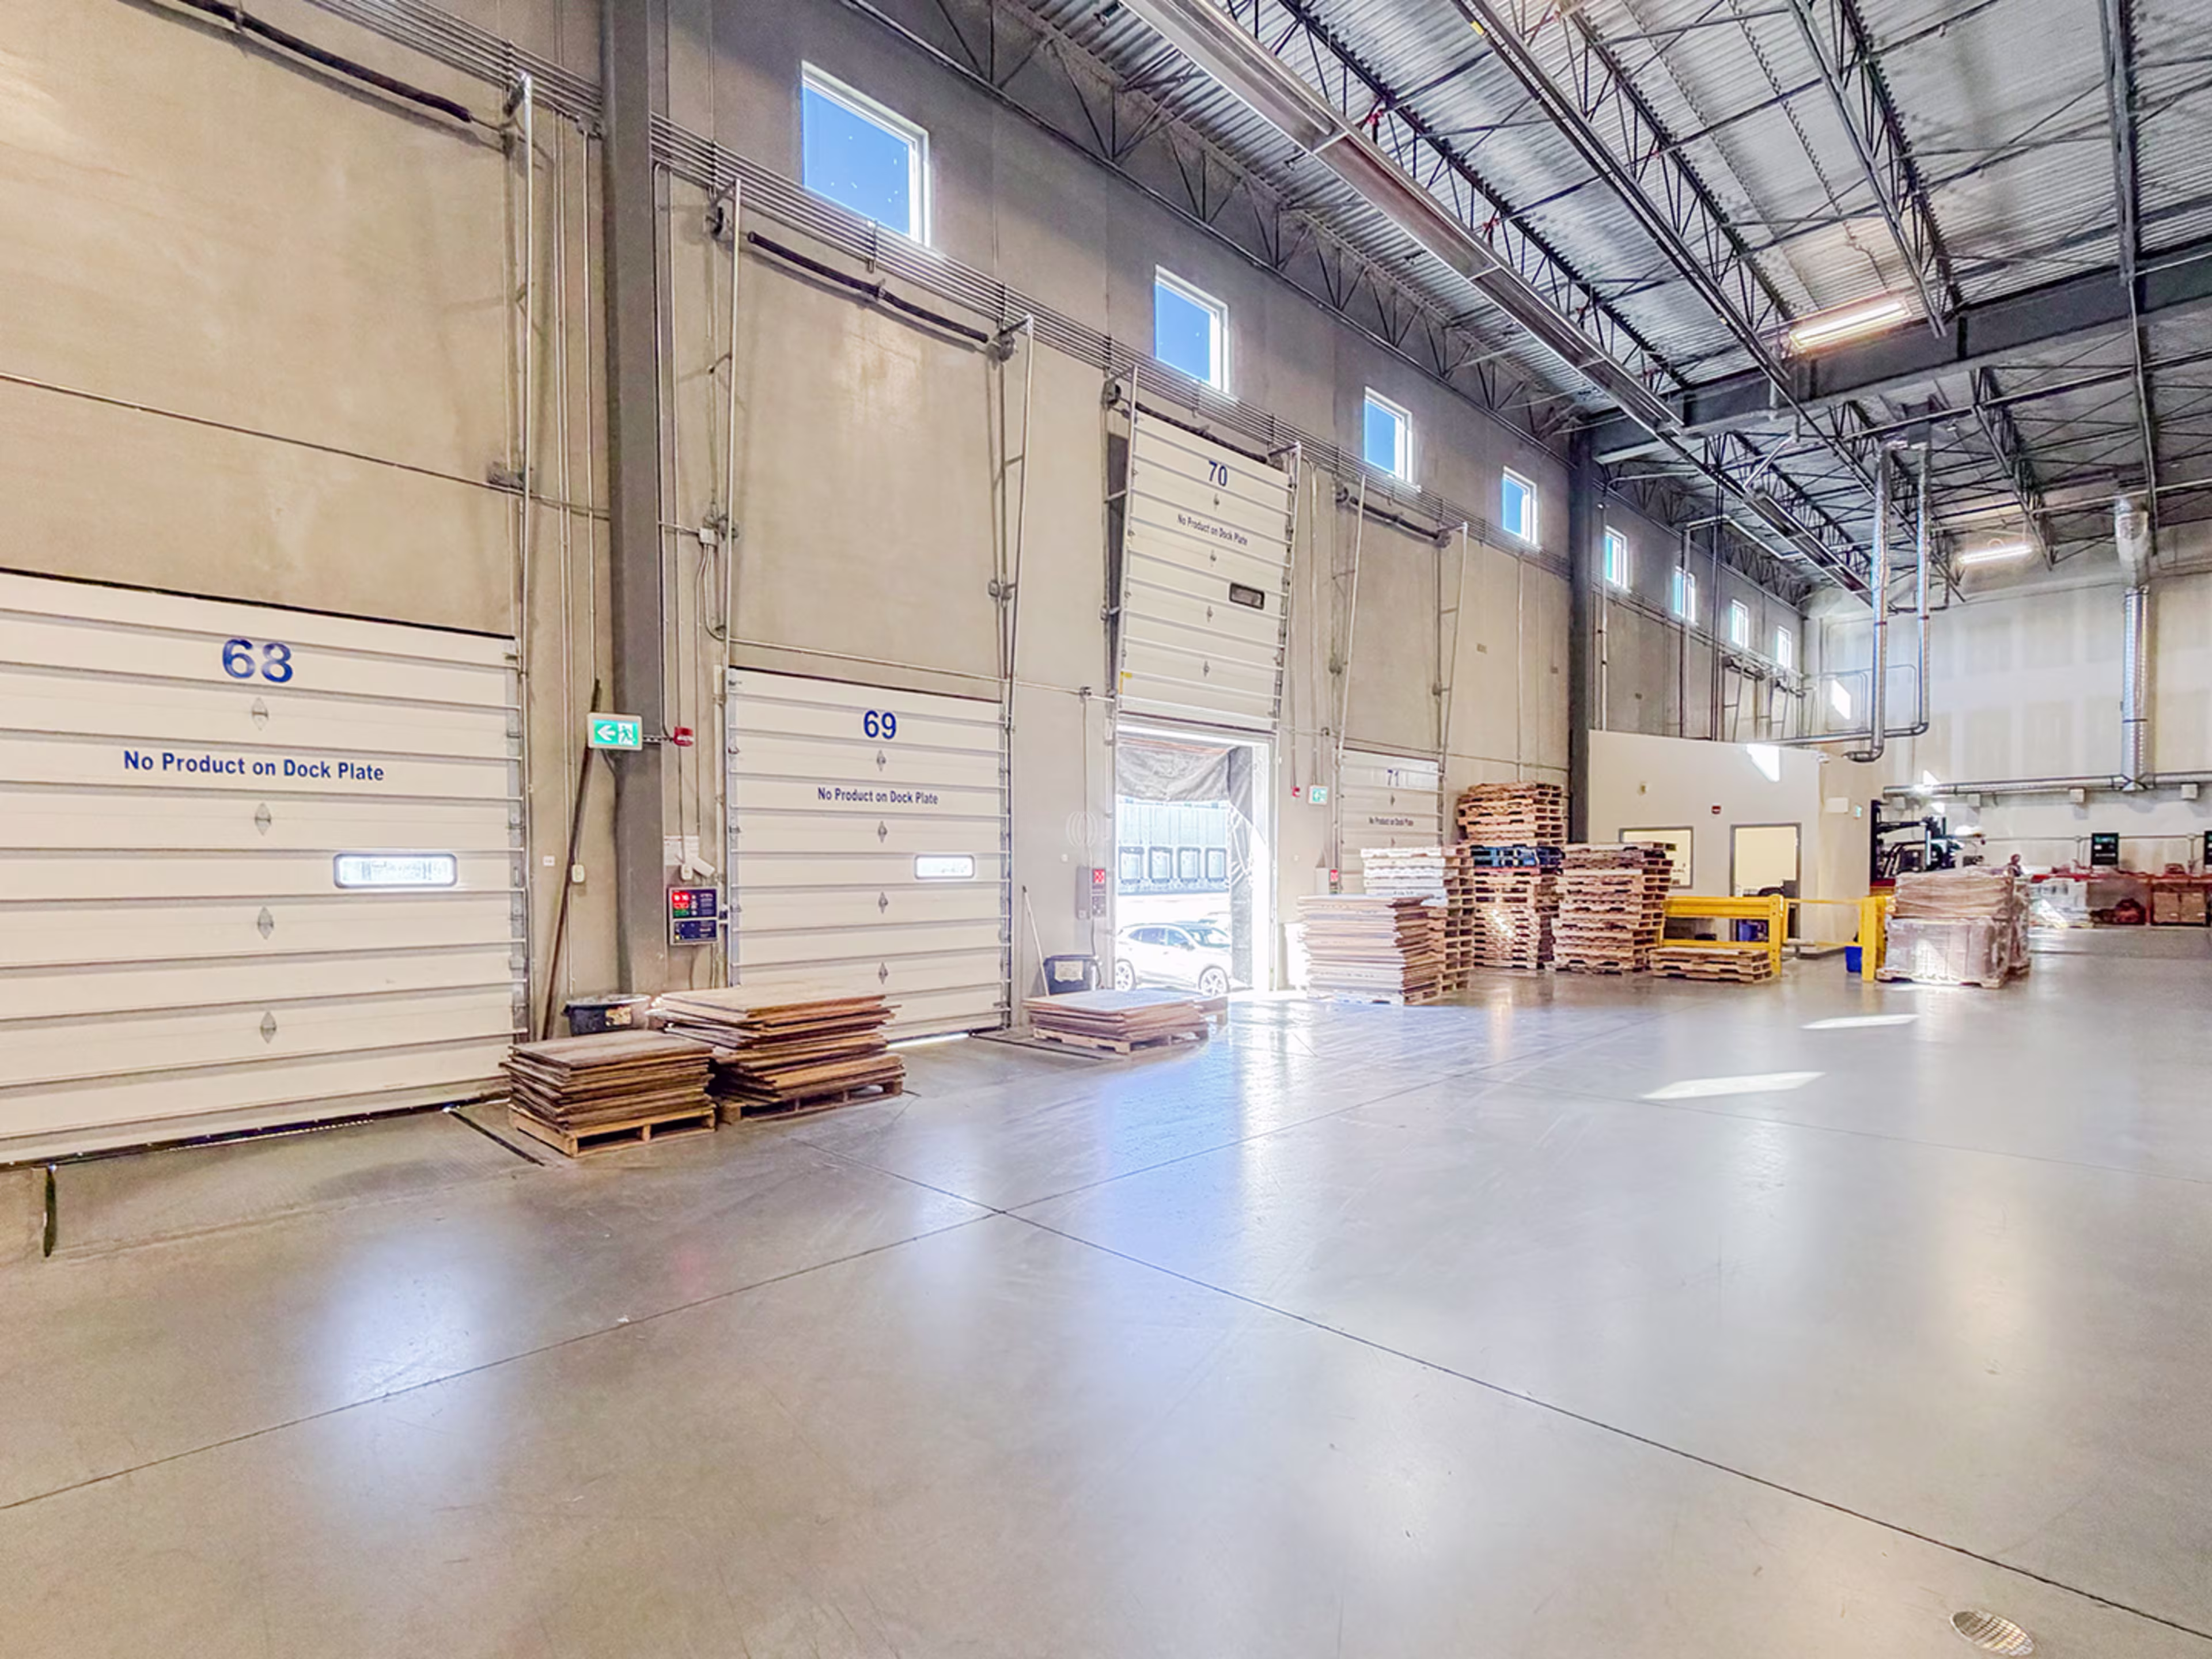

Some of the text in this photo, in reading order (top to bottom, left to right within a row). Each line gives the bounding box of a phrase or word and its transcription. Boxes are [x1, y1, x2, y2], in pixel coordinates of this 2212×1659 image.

[1208, 459, 1228, 487] 70
[222, 638, 293, 683] 68
[863, 710, 896, 740] 69
[124, 751, 384, 781] No Product on Dock Plate
[817, 787, 938, 805] No Product on Dock Plate
